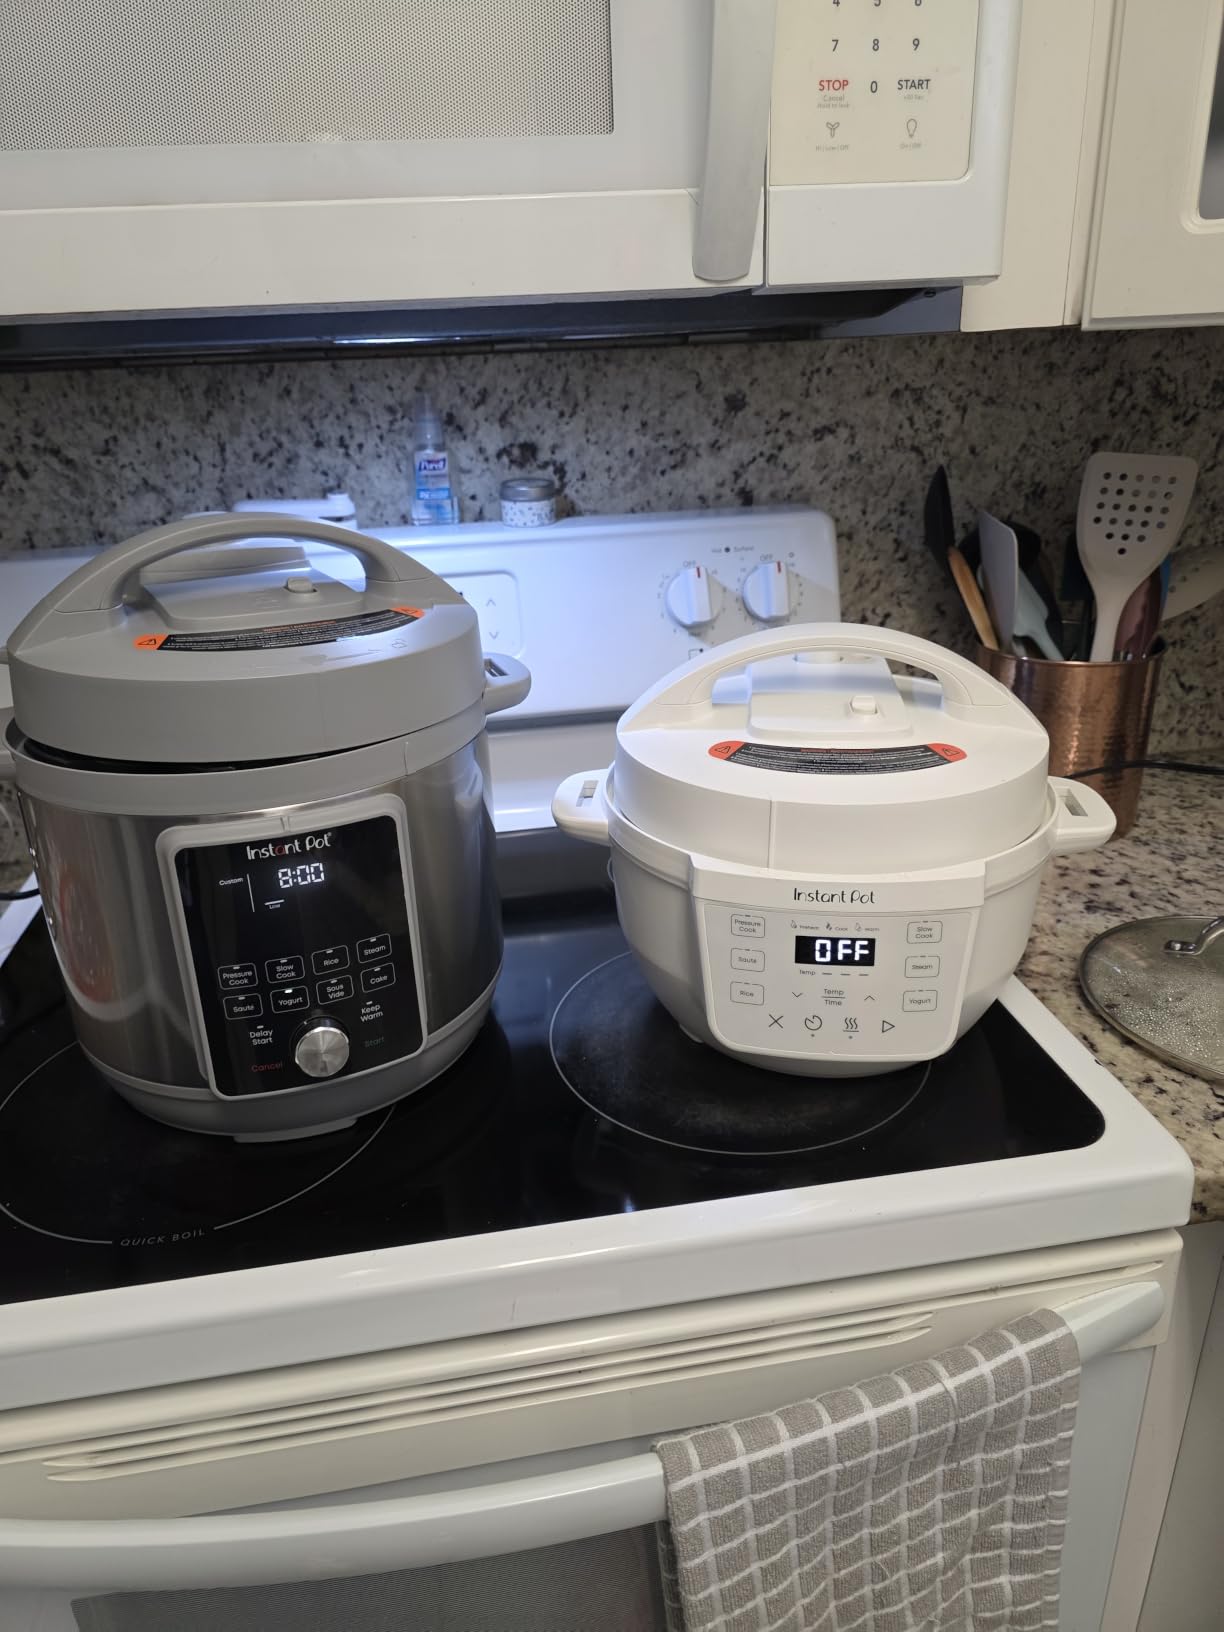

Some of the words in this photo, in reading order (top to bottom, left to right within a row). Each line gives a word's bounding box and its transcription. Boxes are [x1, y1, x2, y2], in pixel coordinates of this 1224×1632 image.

[832, 39, 839, 52] 7
[872, 38, 880, 51] 8
[912, 38, 920, 51] 9
[818, 80, 849, 92] STOP
[870, 81, 878, 93] 0
[897, 79, 931, 90] START
[246, 839, 302, 860] Instant
[278, 862, 325, 889] 8:00
[219, 877, 244, 886] Custom
[793, 887, 846, 904] Instant
[850, 889, 876, 904] Pot
[734, 918, 761, 927] Pressure
[739, 926, 757, 934] Cook
[364, 944, 386, 956] Steam
[323, 956, 339, 966] Rice
[276, 963, 294, 972] Slow
[222, 970, 253, 980] Pressure
[276, 970, 297, 979] Cook
[369, 975, 388, 984] Cake
[228, 977, 249, 986] Cook
[326, 984, 344, 992] Sous
[823, 988, 845, 996] Temp
[328, 990, 345, 1000] Vide
[278, 996, 303, 1007] Yogurt
[361, 1004, 381, 1015] Keep
[360, 1010, 383, 1022] Warm
[249, 1029, 273, 1039] Delay
[252, 1037, 273, 1045] Start
[251, 1061, 283, 1073] Cancel
[120, 1236, 167, 1247] QUICK
[172, 1229, 205, 1241] BOIL
